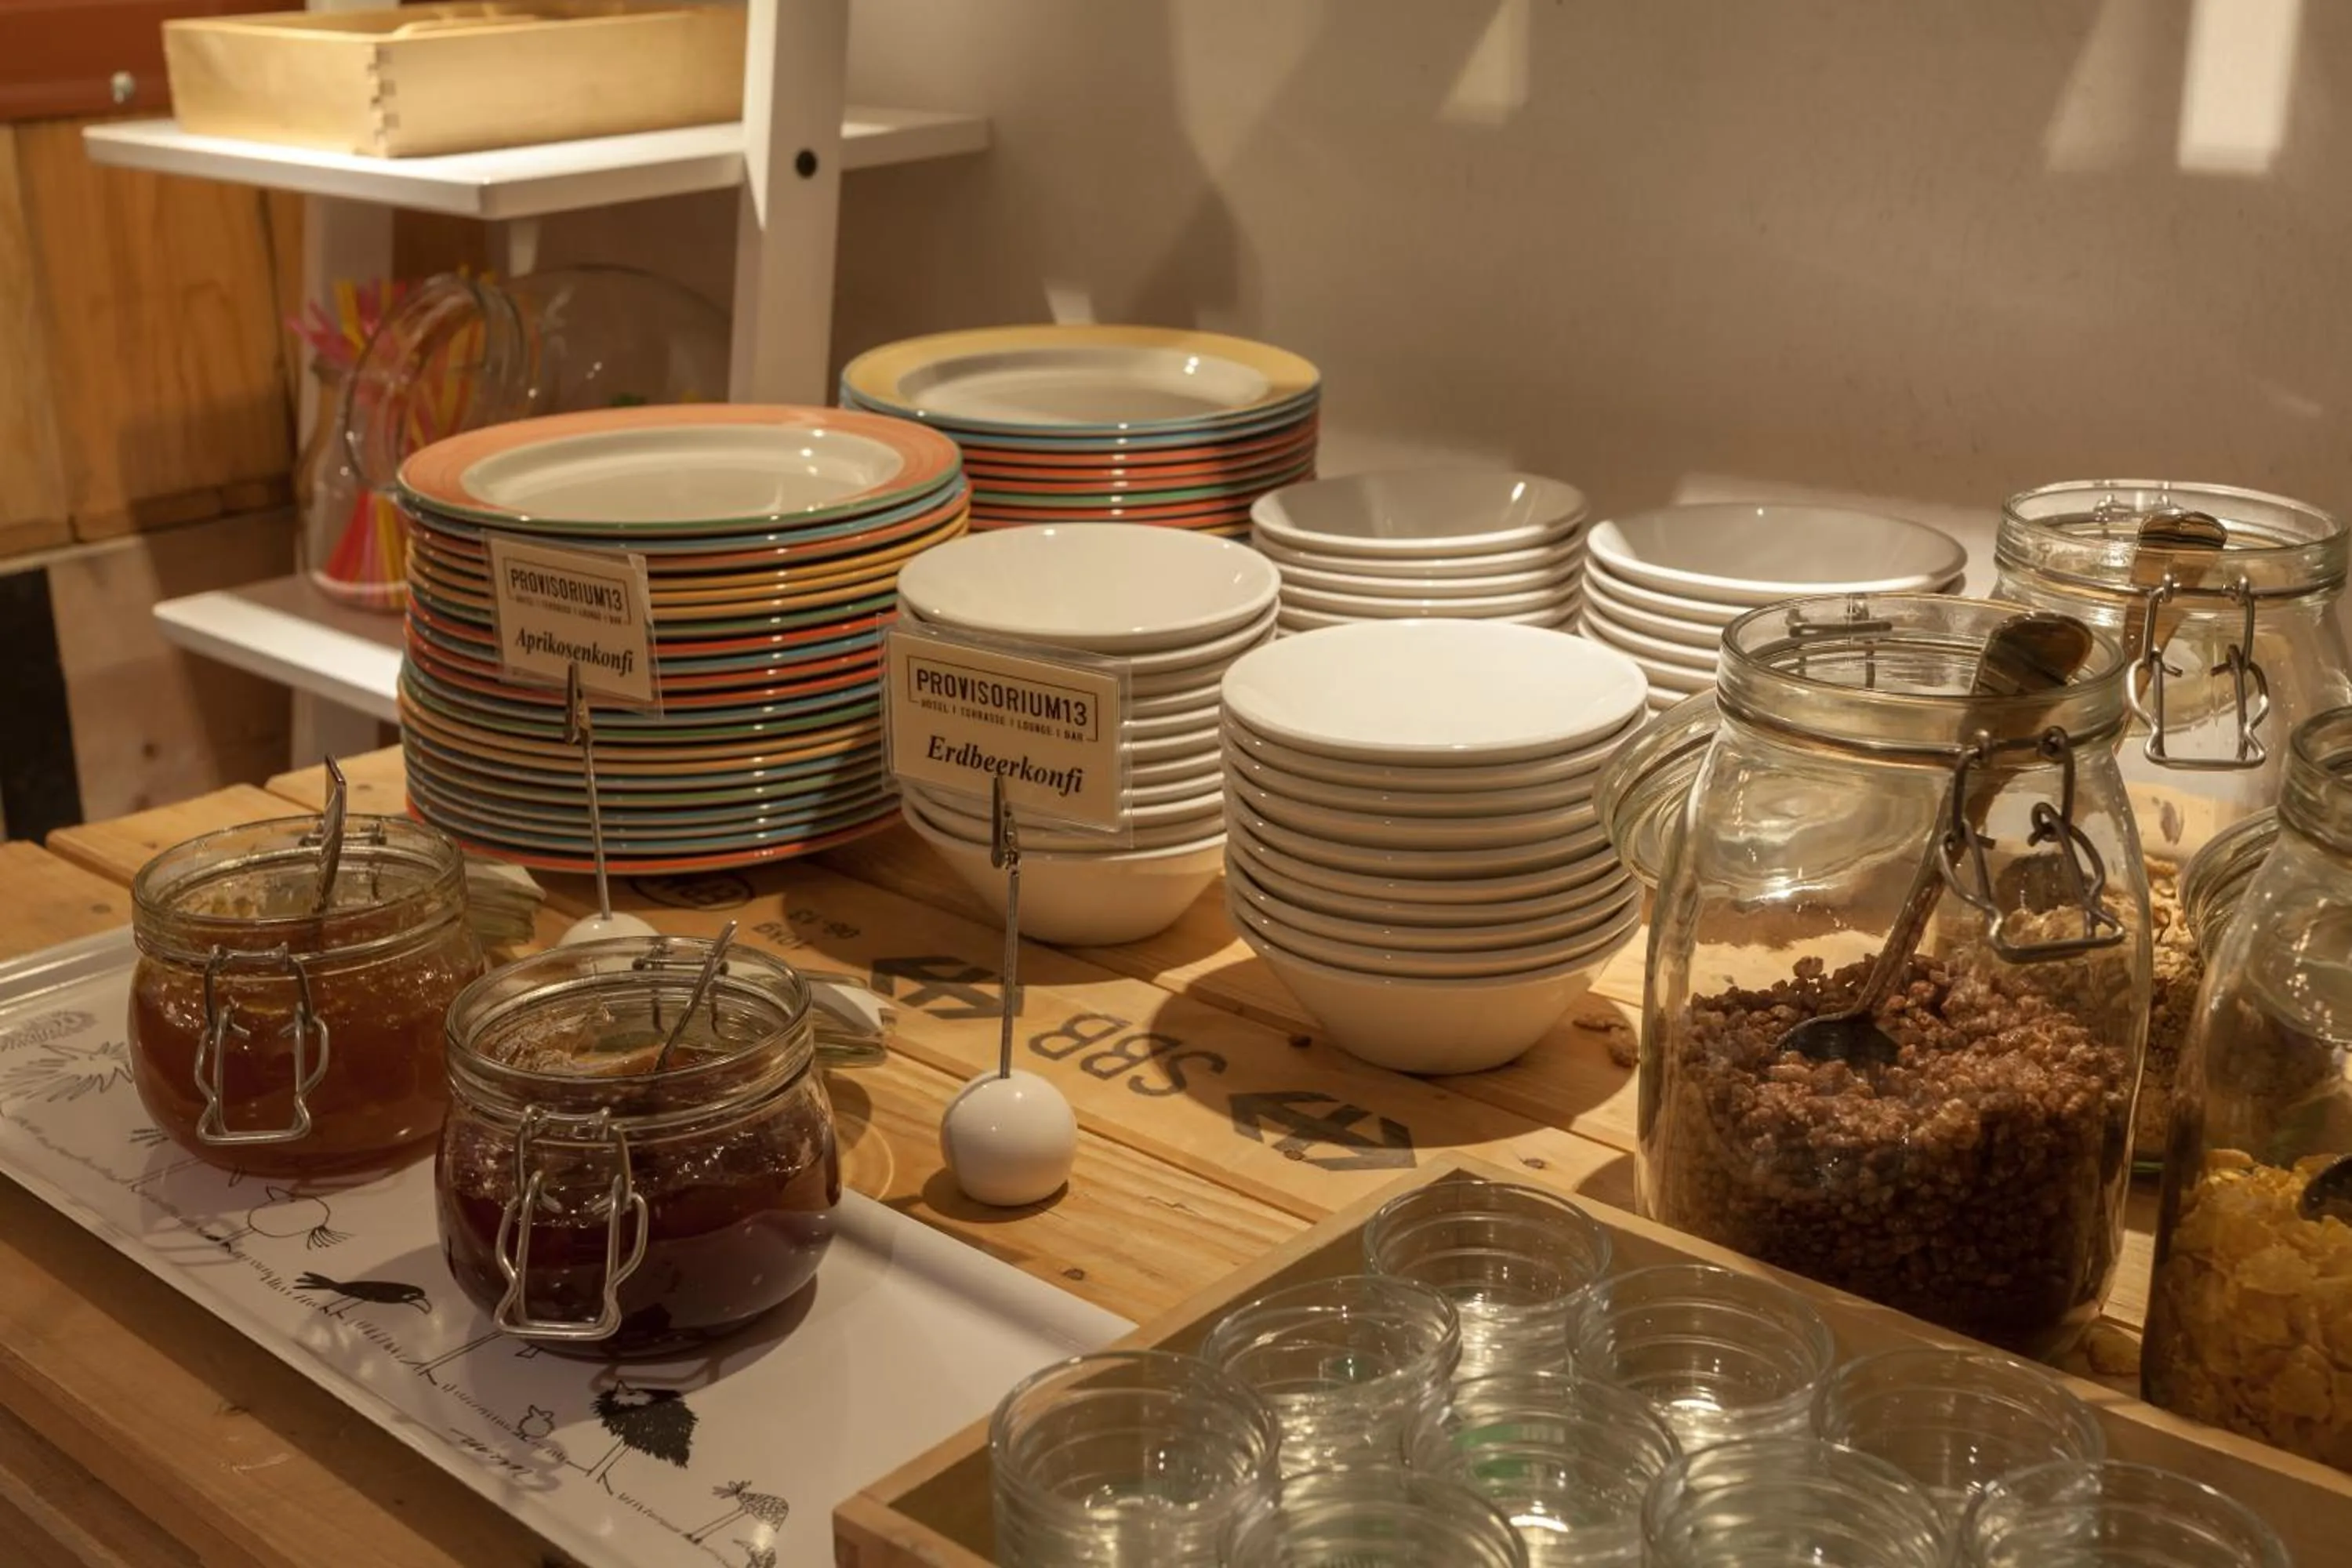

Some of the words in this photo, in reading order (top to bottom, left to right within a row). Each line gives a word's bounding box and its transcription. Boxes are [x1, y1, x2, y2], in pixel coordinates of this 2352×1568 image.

[510, 568, 622, 612] PROVISORIUM13
[514, 627, 634, 677] Aprikosenkonfi
[916, 669, 1088, 727] PROVISORIUM13
[926, 734, 1085, 797] Erdbeerkonfi
[1028, 1012, 1229, 1097] SBB
